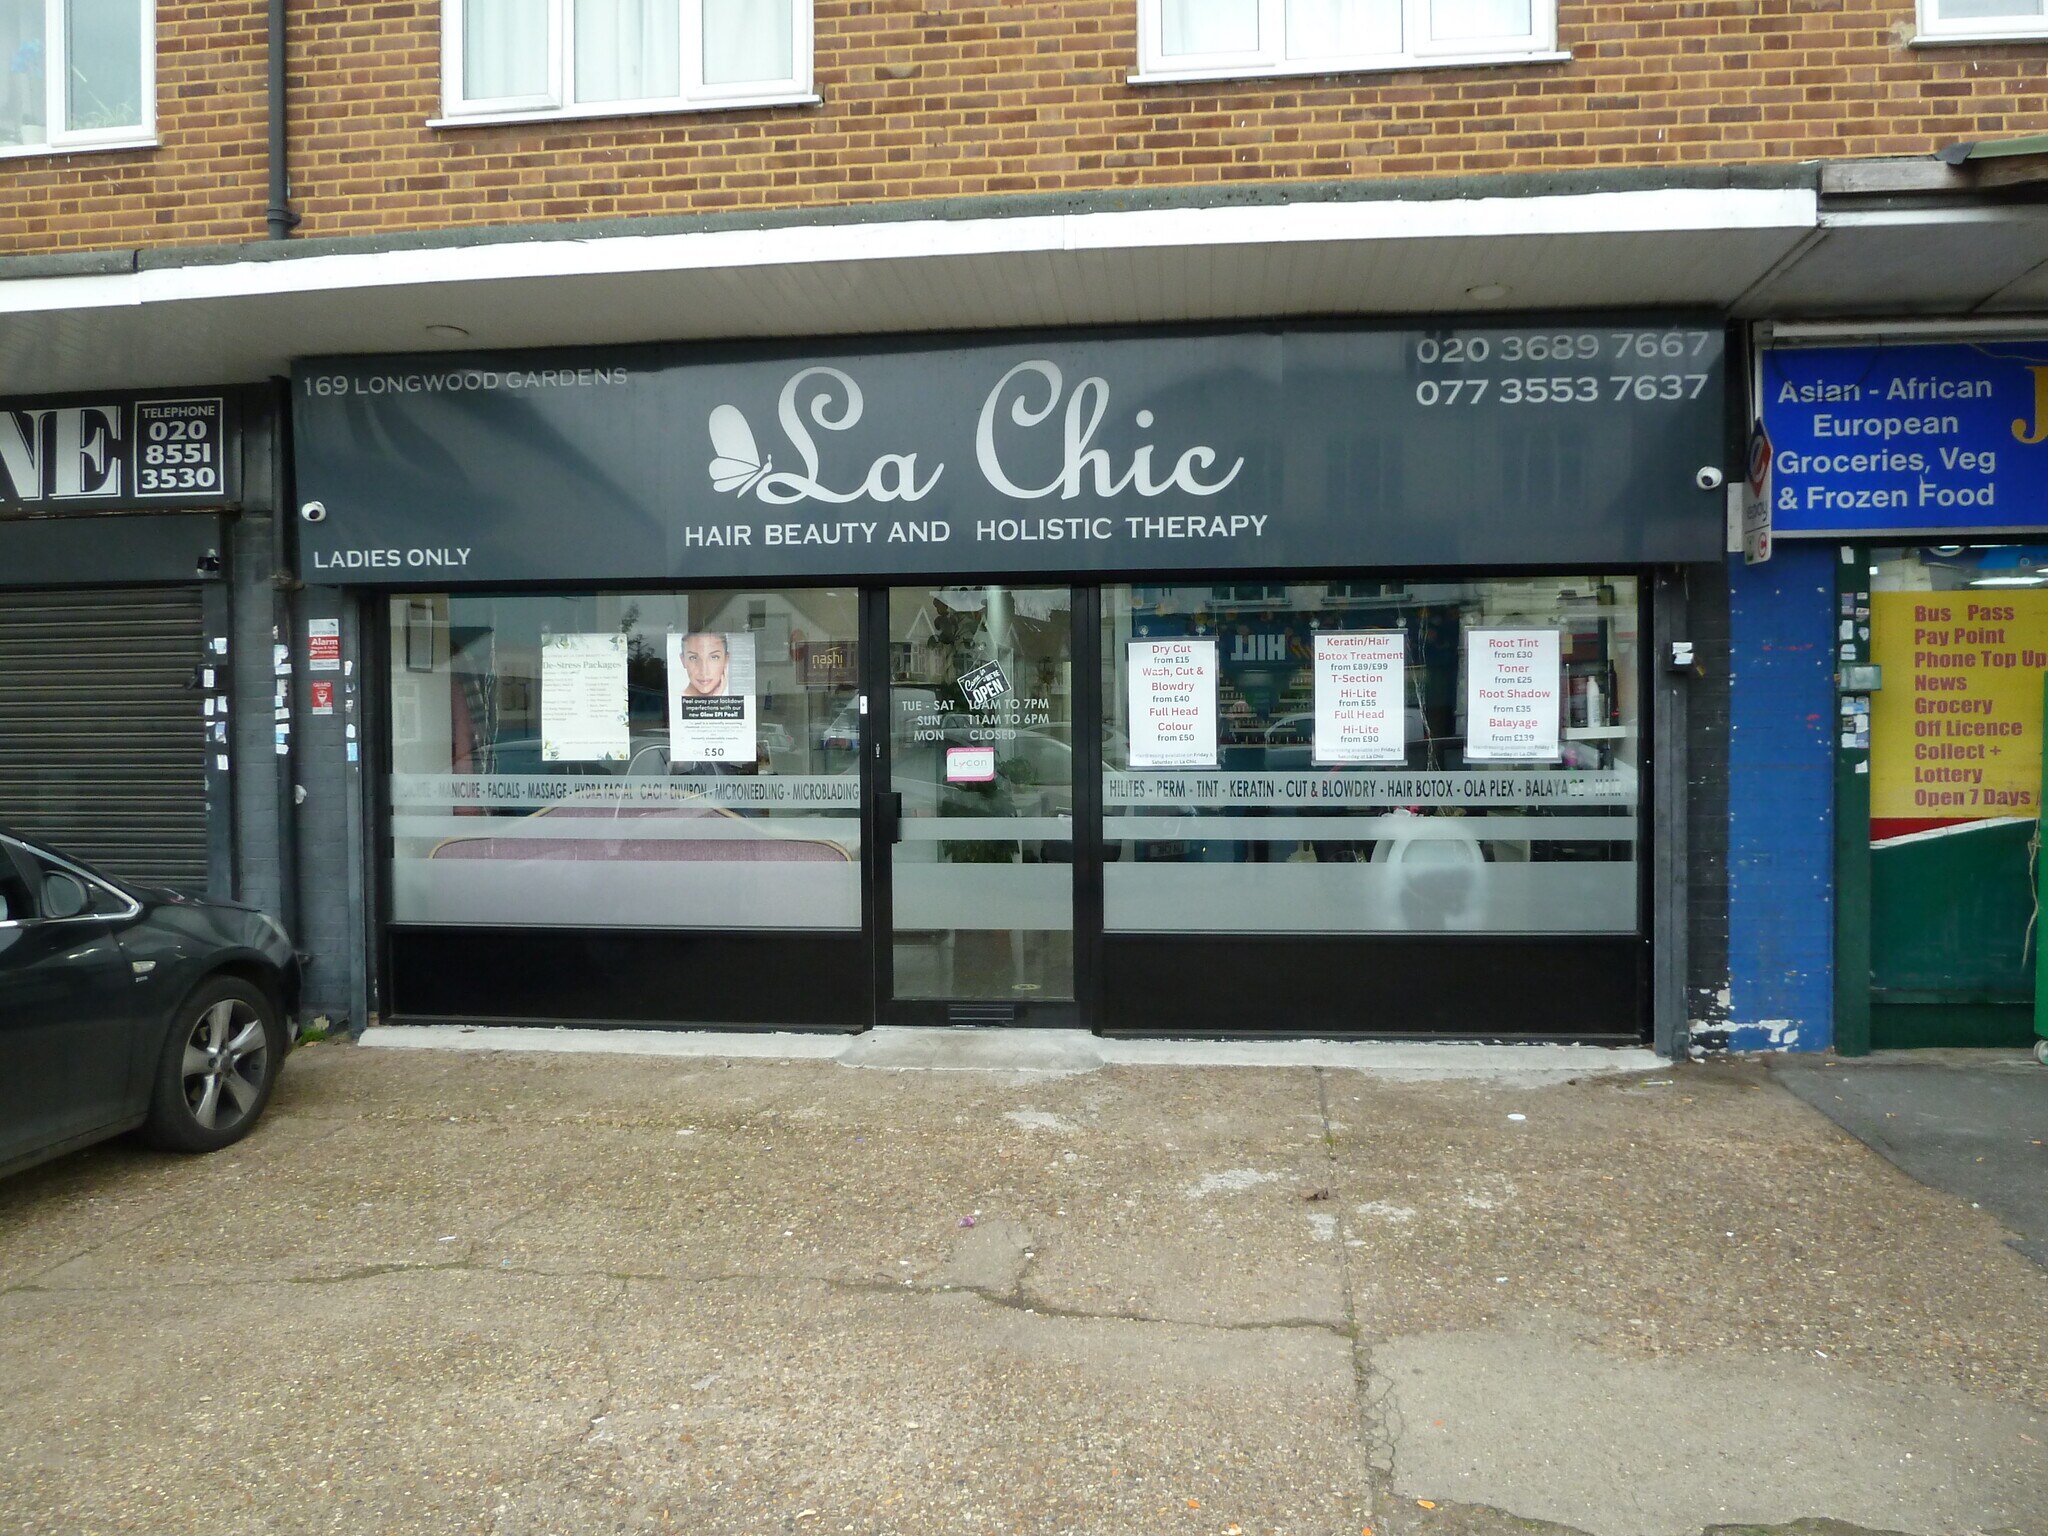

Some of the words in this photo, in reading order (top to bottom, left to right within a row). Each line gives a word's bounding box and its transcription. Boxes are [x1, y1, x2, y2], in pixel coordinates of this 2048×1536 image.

[1417, 337, 1490, 363] 020
[1500, 335, 1599, 361] 3689
[1611, 331, 1709, 359] 7667
[304, 376, 348, 396] 169
[355, 372, 499, 395] LONGWOOD
[506, 368, 628, 389] GARDENS
[1416, 379, 1489, 406] 077
[1499, 377, 1598, 403] 3553
[1609, 374, 1708, 401] 7637
[1777, 379, 1860, 403] Asian
[1886, 376, 1992, 400] African
[142, 406, 215, 418] TELEPHONE
[149, 421, 207, 441] 020
[756, 366, 944, 505] La
[976, 360, 1244, 500] Chic
[1814, 414, 1959, 440] European
[146, 443, 210, 465] 8551
[1777, 448, 1930, 474] Groceries,
[1939, 447, 1996, 474] Veg
[142, 468, 215, 489] 3530
[1777, 487, 1798, 510] &
[1807, 486, 1907, 509] Frozen
[1919, 482, 1995, 507] Food
[685, 525, 751, 546] HAIR
[765, 522, 878, 545] BEAUTY
[887, 521, 950, 542] AND
[976, 517, 1112, 541] HOLISTIC
[1125, 514, 1268, 539] THERAPY
[314, 550, 400, 568] LADIES
[407, 548, 471, 566] ONLY
[1915, 605, 1952, 622] Bus
[1967, 604, 2015, 621] Pass
[1327, 637, 1389, 646] Keratin/Hair
[1489, 639, 1515, 647] Root
[1518, 638, 1539, 647] Tint
[1915, 628, 1949, 646] Pay
[1954, 627, 2005, 645] Point
[1152, 645, 1170, 655] Dry
[1173, 645, 1191, 653] Cut
[1319, 652, 1347, 660] Botox
[1350, 652, 1404, 660] Treatment
[812, 651, 843, 664] nashi
[1915, 651, 1976, 668] Phone
[1981, 650, 2016, 669] Top
[2022, 650, 2047, 668] Up
[543, 661, 581, 669] De-Stress
[583, 661, 622, 670] Packages
[1353, 663, 1388, 671] £89/£99
[1498, 664, 1529, 673] Toner
[1142, 667, 1173, 677] Wash,
[1175, 667, 1194, 675] Cut
[1196, 667, 1204, 675] &
[1332, 674, 1383, 683] T-Section
[1495, 676, 1515, 684] from
[1517, 676, 1532, 684] £25
[1915, 675, 1967, 691] News
[973, 678, 1004, 703] OPEN
[1152, 682, 1194, 692] Blowdry
[1341, 689, 1377, 698] Hi-Lite
[1479, 689, 1504, 698] Root
[1507, 689, 1550, 698] Shadow
[902, 700, 921, 711] TUE
[934, 700, 954, 711] SAT
[1005, 700, 1020, 709] TO
[1024, 699, 1049, 709] 7PM
[1339, 699, 1359, 707] from
[1493, 705, 1514, 713] from
[1516, 705, 1531, 713] £35
[1915, 697, 1993, 715] Grocery
[1149, 707, 1168, 716] Full
[1172, 707, 1198, 716] Head
[1334, 710, 1354, 719] Full
[1357, 710, 1384, 719] Head
[918, 715, 941, 726] SUN
[969, 715, 1001, 724] 11AM
[1005, 714, 1020, 724] TO
[1024, 714, 1050, 724] 6PM
[1489, 718, 1538, 729] Balayage
[1158, 722, 1193, 731] Colour
[1343, 725, 1379, 734] Hi-Lite
[1915, 720, 1942, 737] Off
[1946, 719, 2023, 736] Licence
[914, 730, 944, 741] MON
[970, 730, 1016, 740] CLOSED
[704, 748, 724, 757] £50
[1915, 743, 1985, 760] Collect
[953, 759, 987, 767] Lycon
[1915, 766, 1983, 784] Lottery
[487, 782, 520, 799] FACIALS
[527, 782, 567, 799] MASSAGE
[574, 783, 601, 799] HYDRA
[604, 783, 633, 800] FACIAL
[640, 783, 662, 800] CACI
[715, 783, 784, 800] MICRONEEDLING
[792, 783, 859, 800] MICROBLADING
[1109, 779, 1145, 798] HILITES
[1156, 779, 1186, 797] PERM
[1196, 779, 1219, 797] TINT
[1229, 779, 1274, 797] KERATIN
[1285, 779, 1307, 797] CUT
[1311, 780, 1318, 797] &
[1322, 779, 1376, 798] BLOWDRY
[1387, 779, 1412, 797] HAIR
[1416, 779, 1453, 797] BOTOX
[1464, 779, 1486, 797] OLA
[1490, 779, 1514, 797] PLEX
[1915, 789, 1964, 807] Open
[1969, 789, 1979, 805] 7
[1983, 788, 2030, 807] Days
